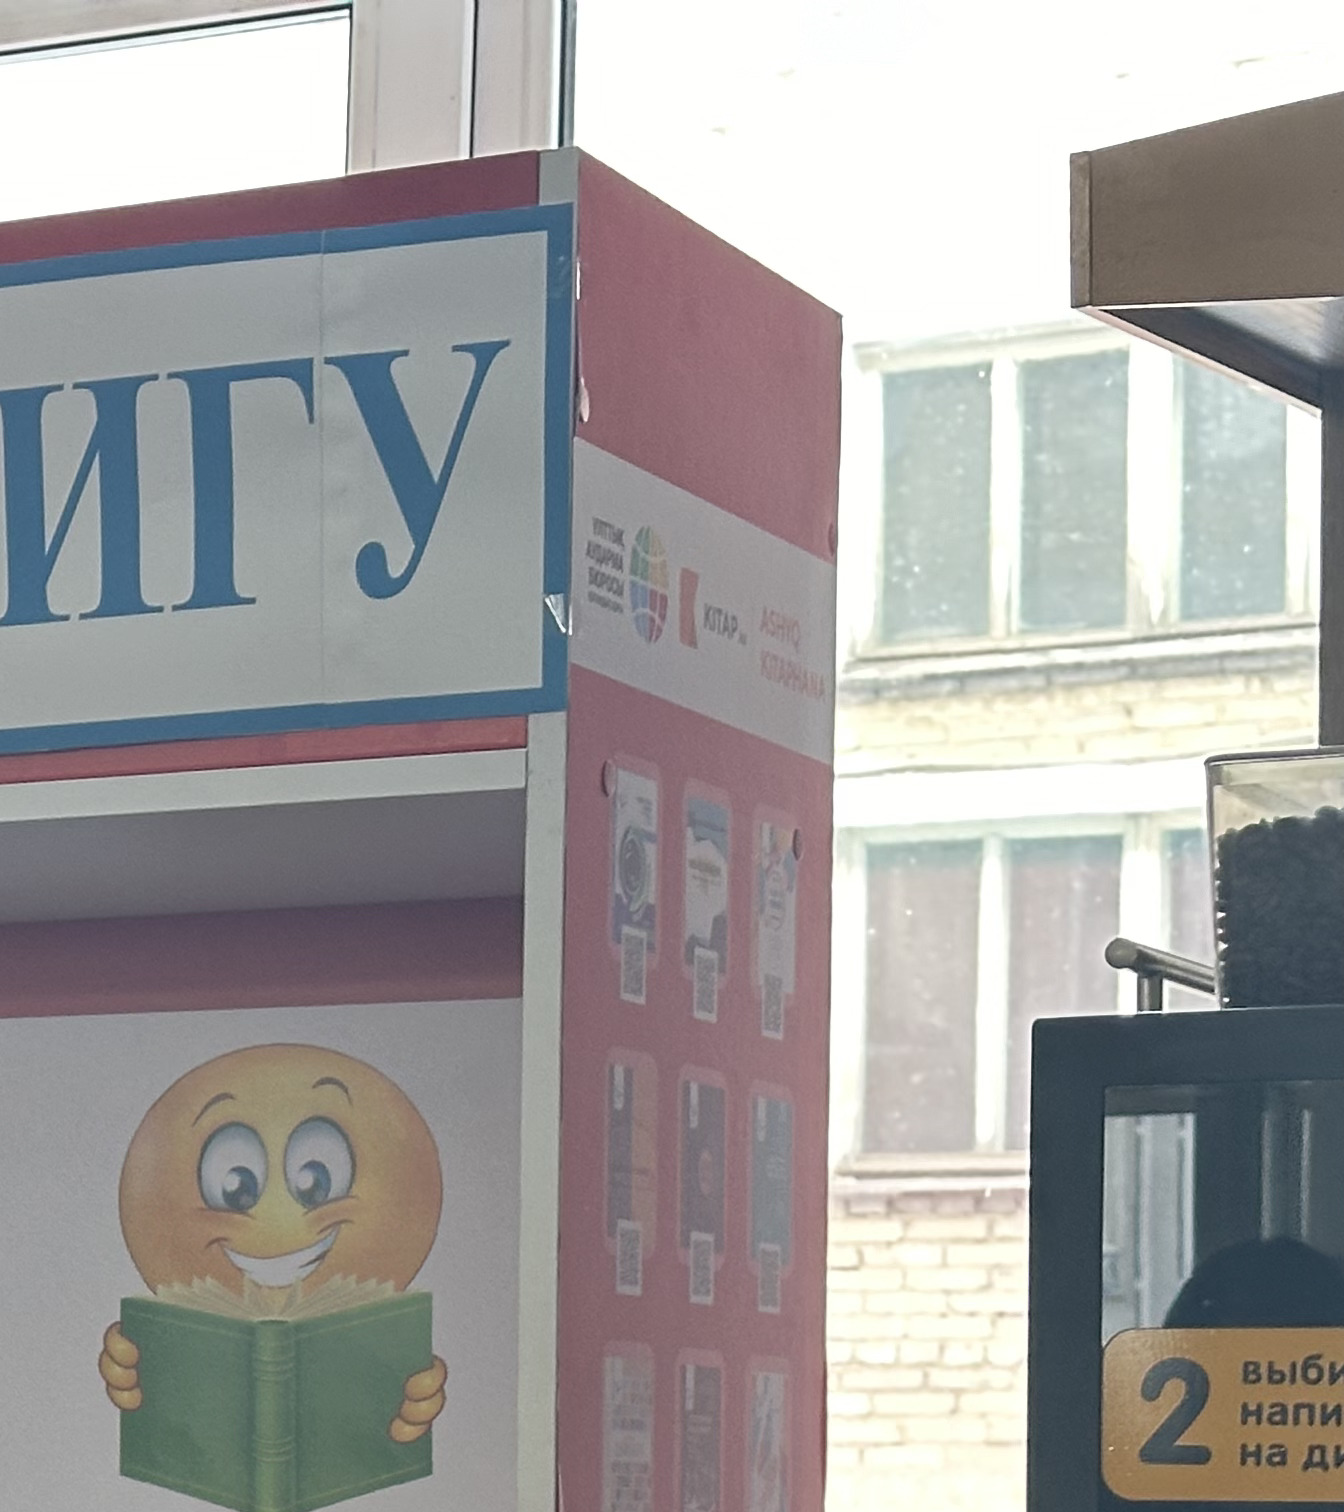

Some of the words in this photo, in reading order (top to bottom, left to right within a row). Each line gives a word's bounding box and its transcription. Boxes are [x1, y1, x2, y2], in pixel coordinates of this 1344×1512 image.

[704, 602, 738, 640] KITAP
[1139, 1357, 1212, 1465] 2
[1240, 1401, 1343, 1427] напи
[1240, 1443, 1288, 1467] на
